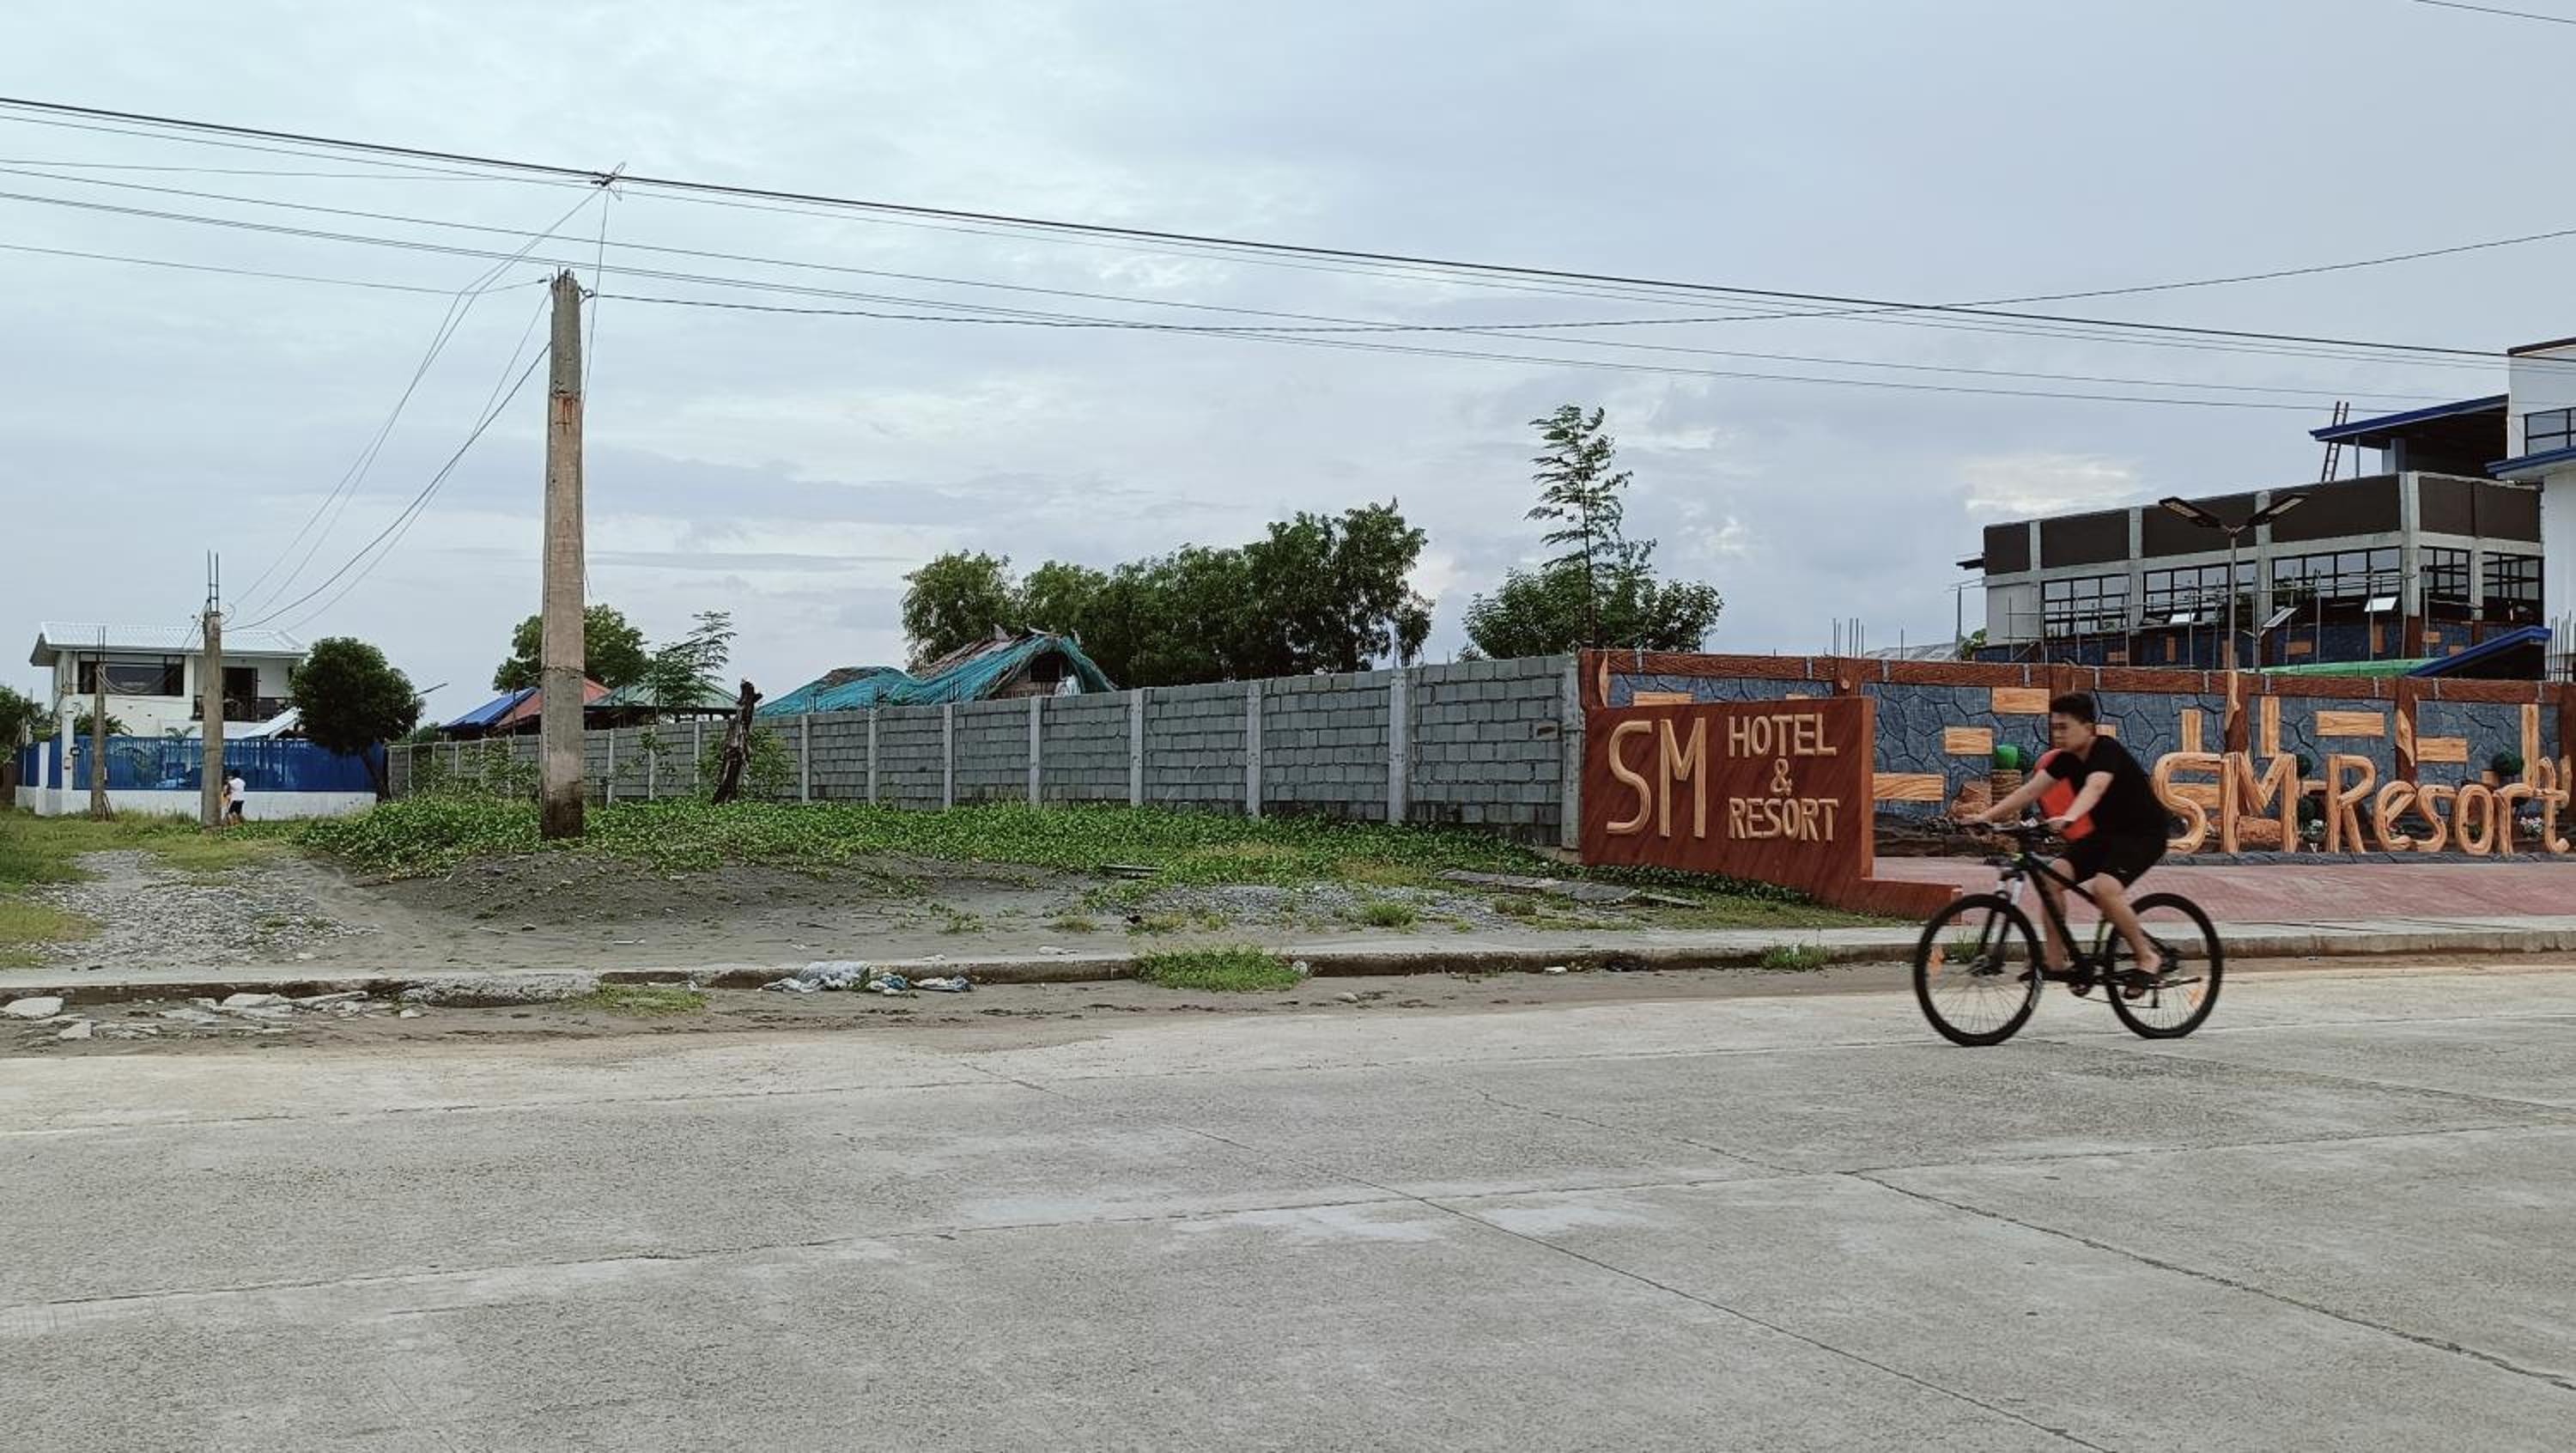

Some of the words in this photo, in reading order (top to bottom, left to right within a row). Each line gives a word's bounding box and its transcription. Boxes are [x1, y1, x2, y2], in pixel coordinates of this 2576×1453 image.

[1728, 714, 1837, 757] HOTEL
[1607, 716, 1706, 839] SM
[1770, 758, 1793, 795] &
[1728, 797, 1839, 842] RESORT
[2153, 751, 2298, 853] SM
[2326, 753, 2571, 855] Resort
